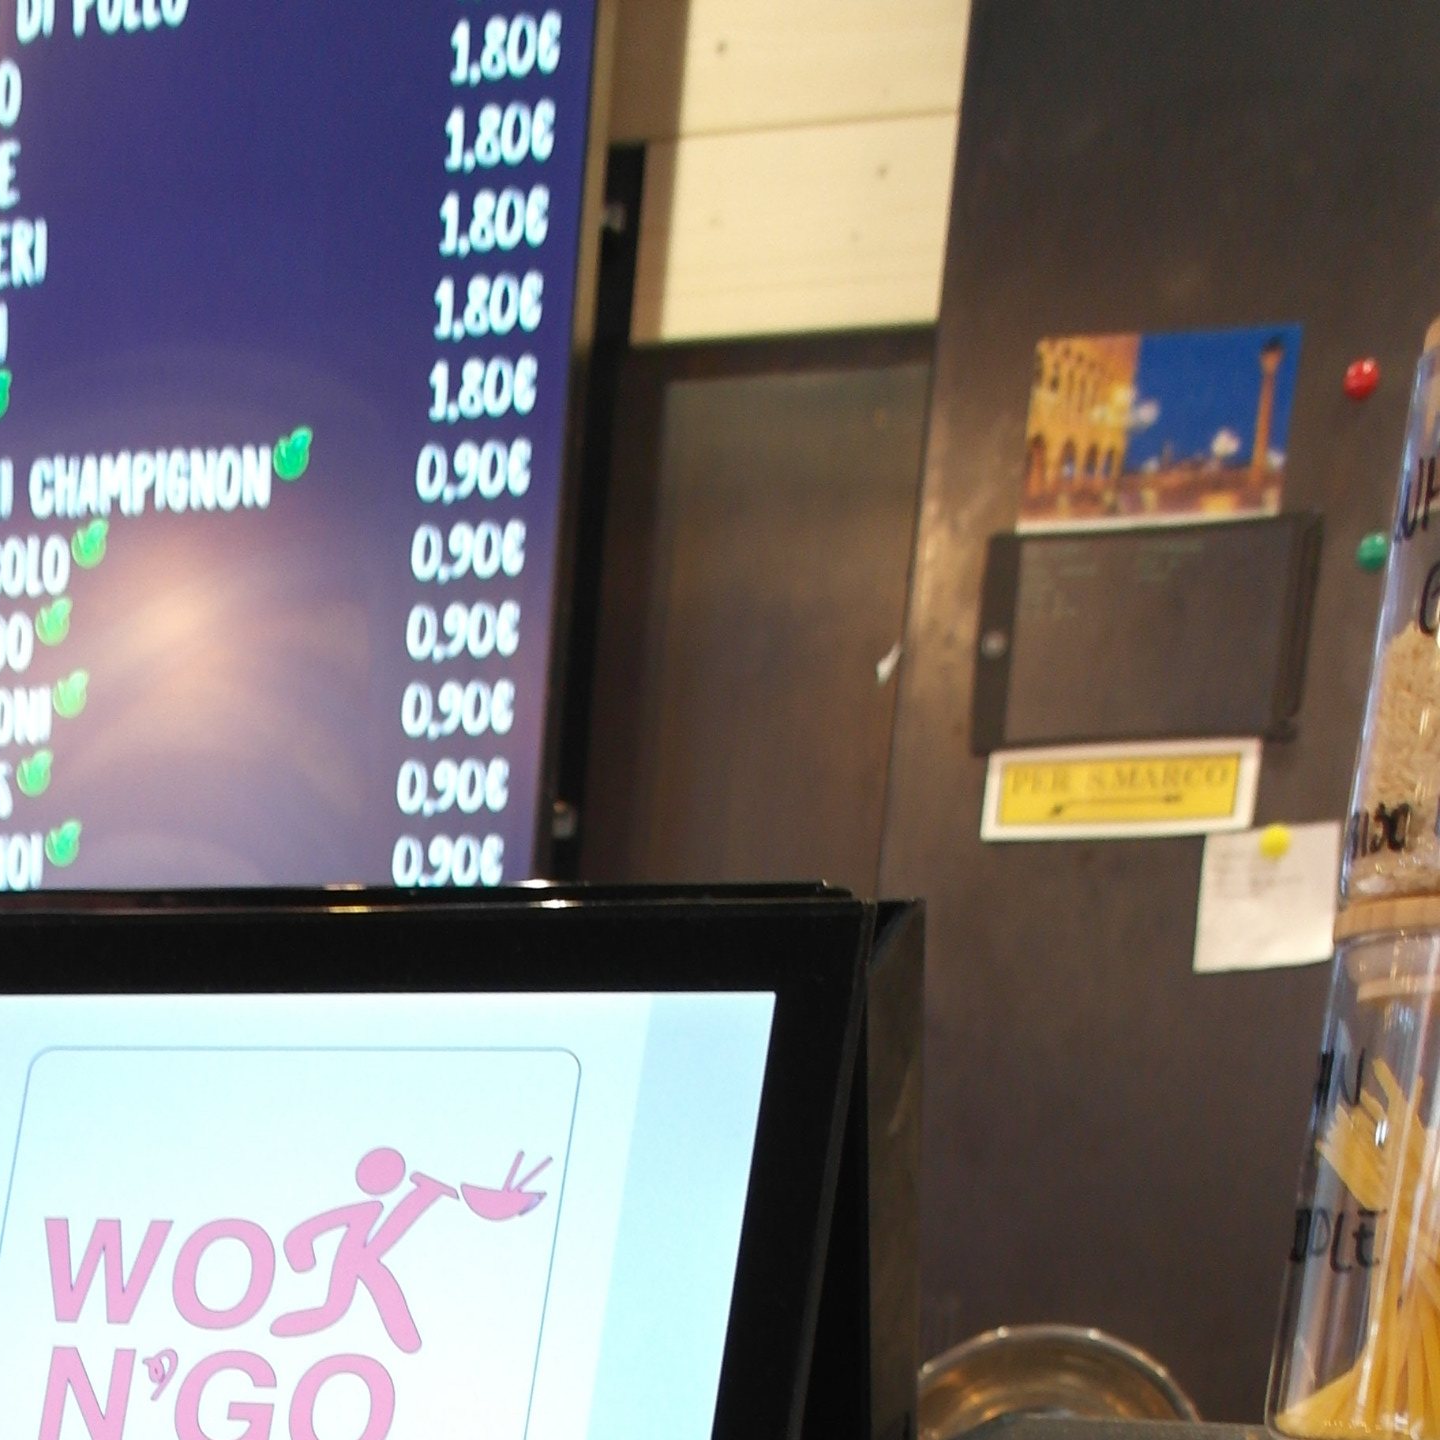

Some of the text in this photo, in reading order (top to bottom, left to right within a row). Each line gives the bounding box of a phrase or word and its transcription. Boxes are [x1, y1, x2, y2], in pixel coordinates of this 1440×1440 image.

[450, 9, 562, 86] 1,80€
[444, 97, 556, 174] 1,80€
[439, 184, 551, 258] 1,80€
[433, 270, 544, 341] 1,80€
[428, 354, 538, 424] 1,80€
[29, 444, 272, 519] CHAMPIGNON
[415, 436, 532, 504] 0,90€
[410, 518, 526, 584] 0,90€
[406, 599, 521, 663] 0,90€
[400, 677, 515, 740] 0,90€
[396, 756, 510, 818] 0,90€
[42, 1170, 445, 1355] WOK
